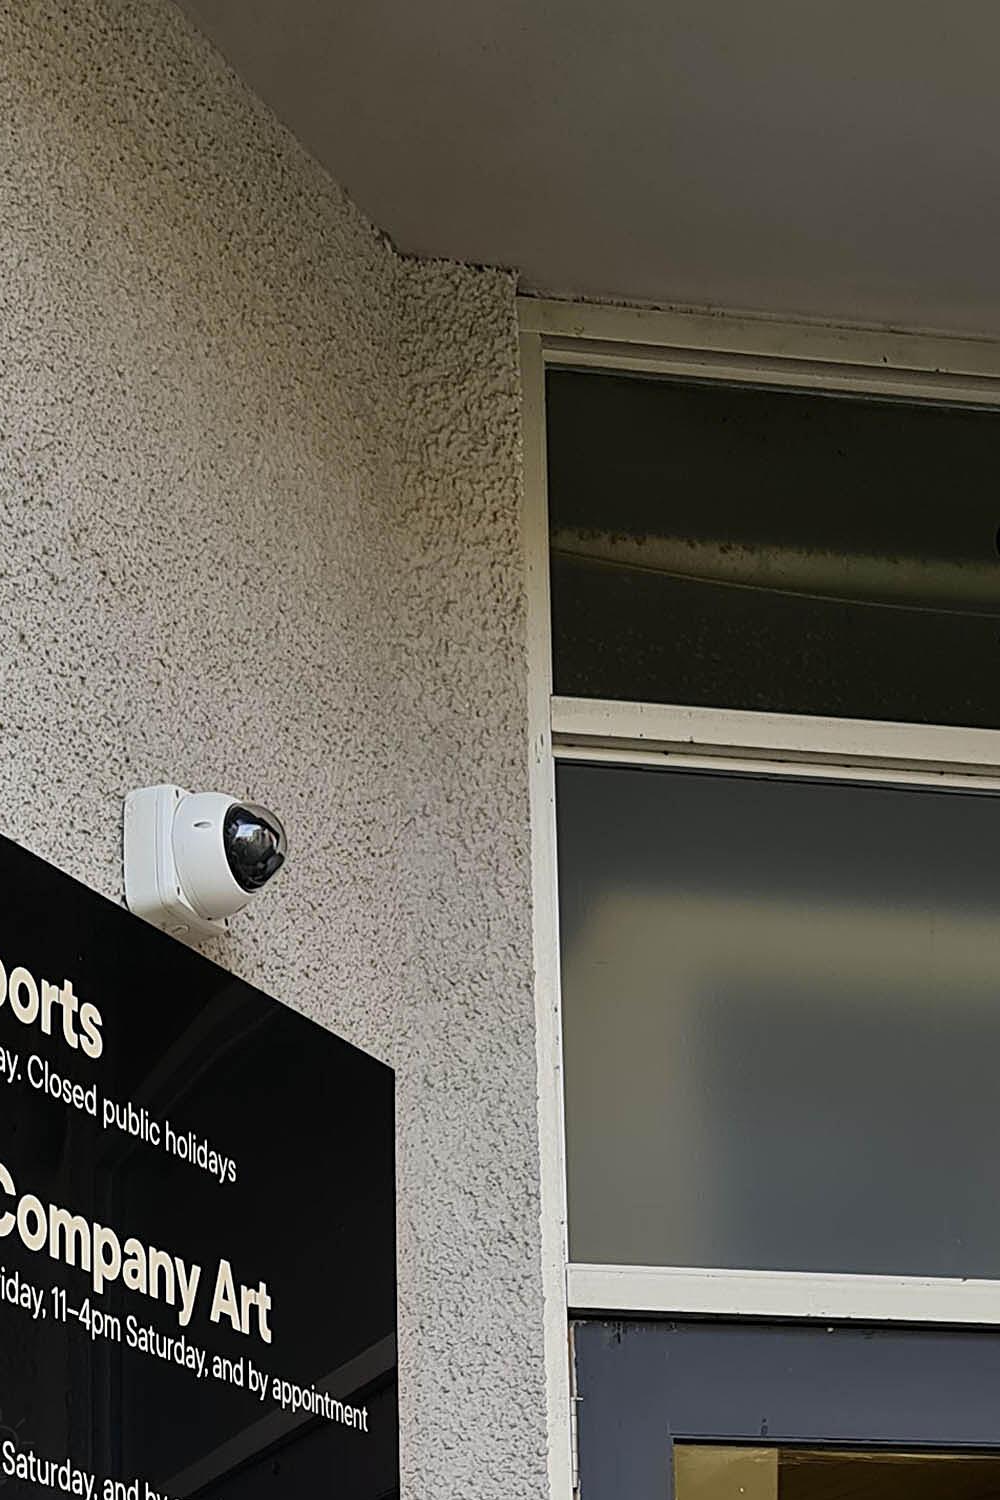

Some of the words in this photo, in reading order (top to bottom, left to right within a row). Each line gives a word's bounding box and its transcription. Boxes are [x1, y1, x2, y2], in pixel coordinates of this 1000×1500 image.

[27, 1054, 97, 1117] Closed
[103, 1098, 161, 1146] public
[165, 1120, 237, 1184] holidays
[209, 1258, 272, 1344] Art
[126, 1314, 209, 1378] Saturday,
[212, 1355, 244, 1387] and
[248, 1359, 269, 1401] by
[272, 1378, 369, 1433] appointment
